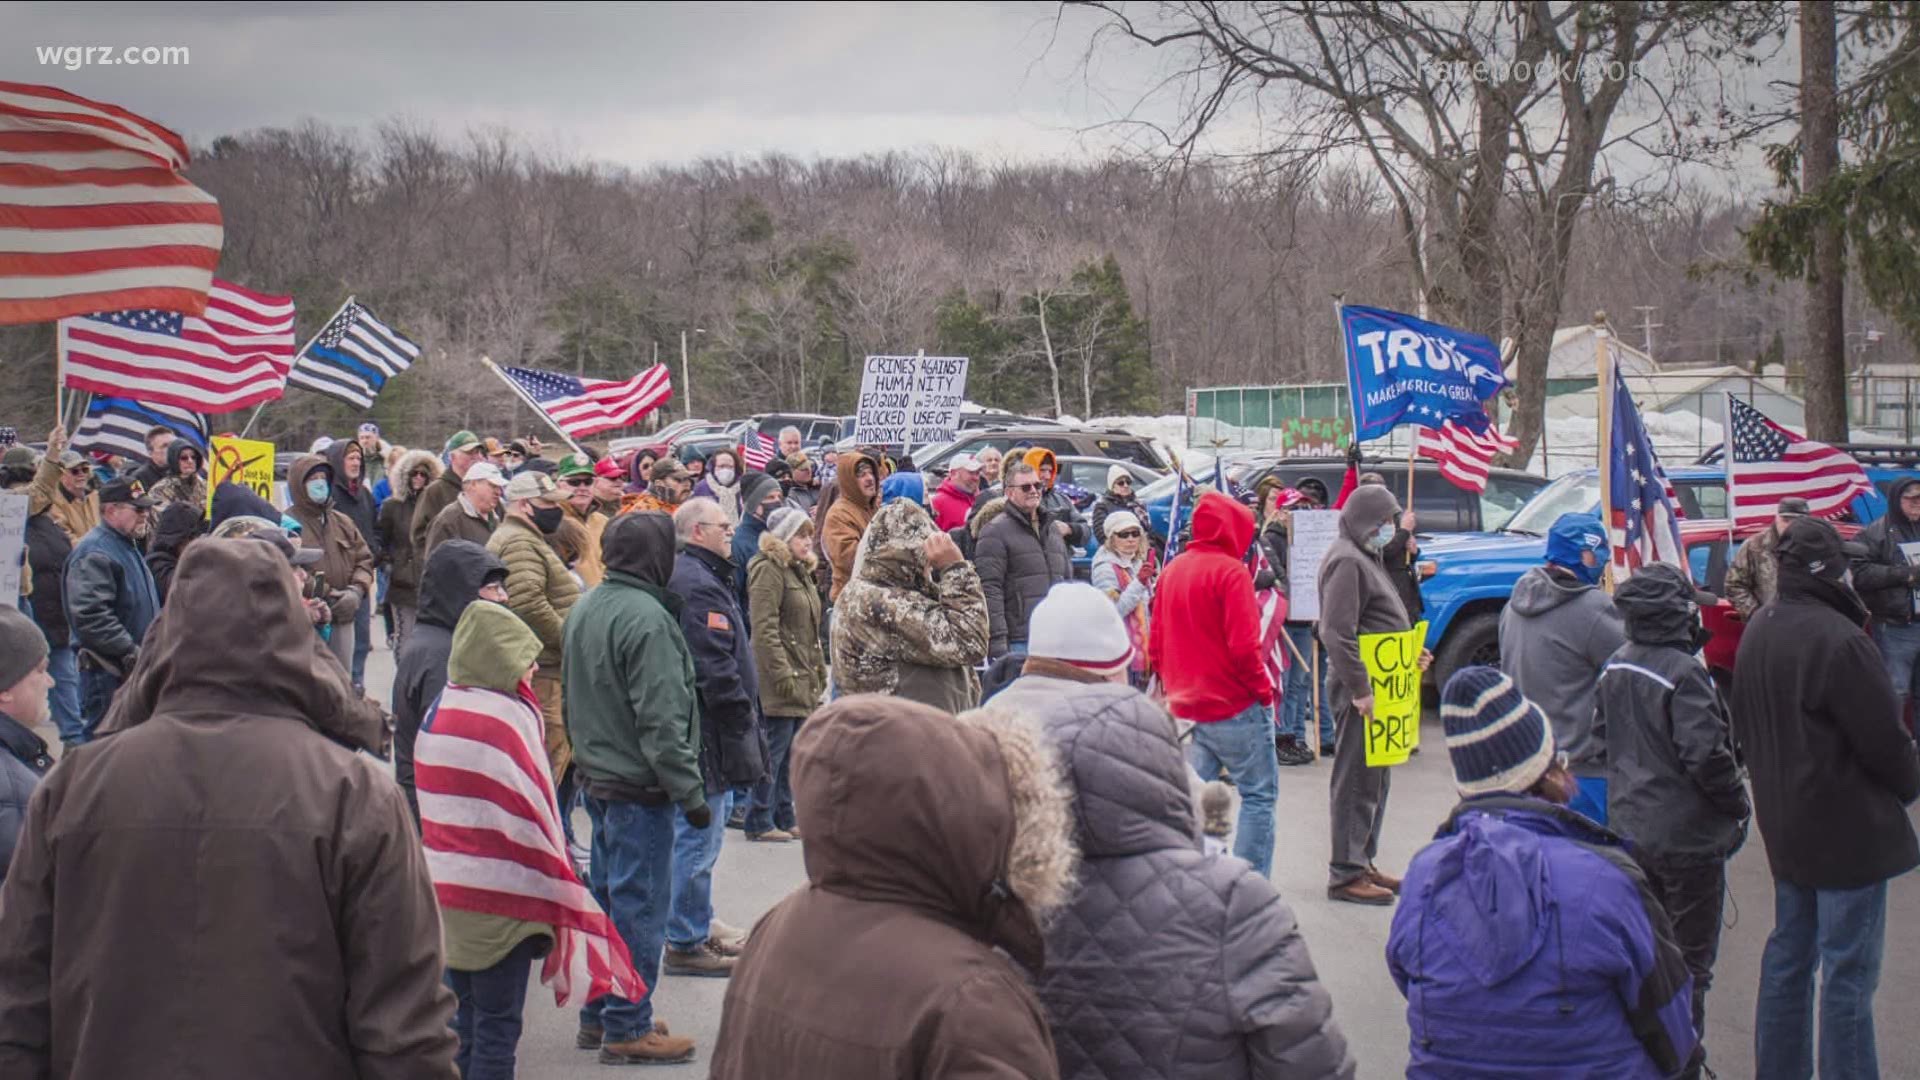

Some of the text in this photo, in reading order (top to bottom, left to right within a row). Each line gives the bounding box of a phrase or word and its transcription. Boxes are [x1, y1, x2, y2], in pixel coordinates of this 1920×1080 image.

[920, 359, 965, 375] AGAINST
[875, 375, 955, 391] HUMANITY
[1366, 383, 1397, 407] MAKE
[860, 410, 953, 426] BLOCKED USE OF
